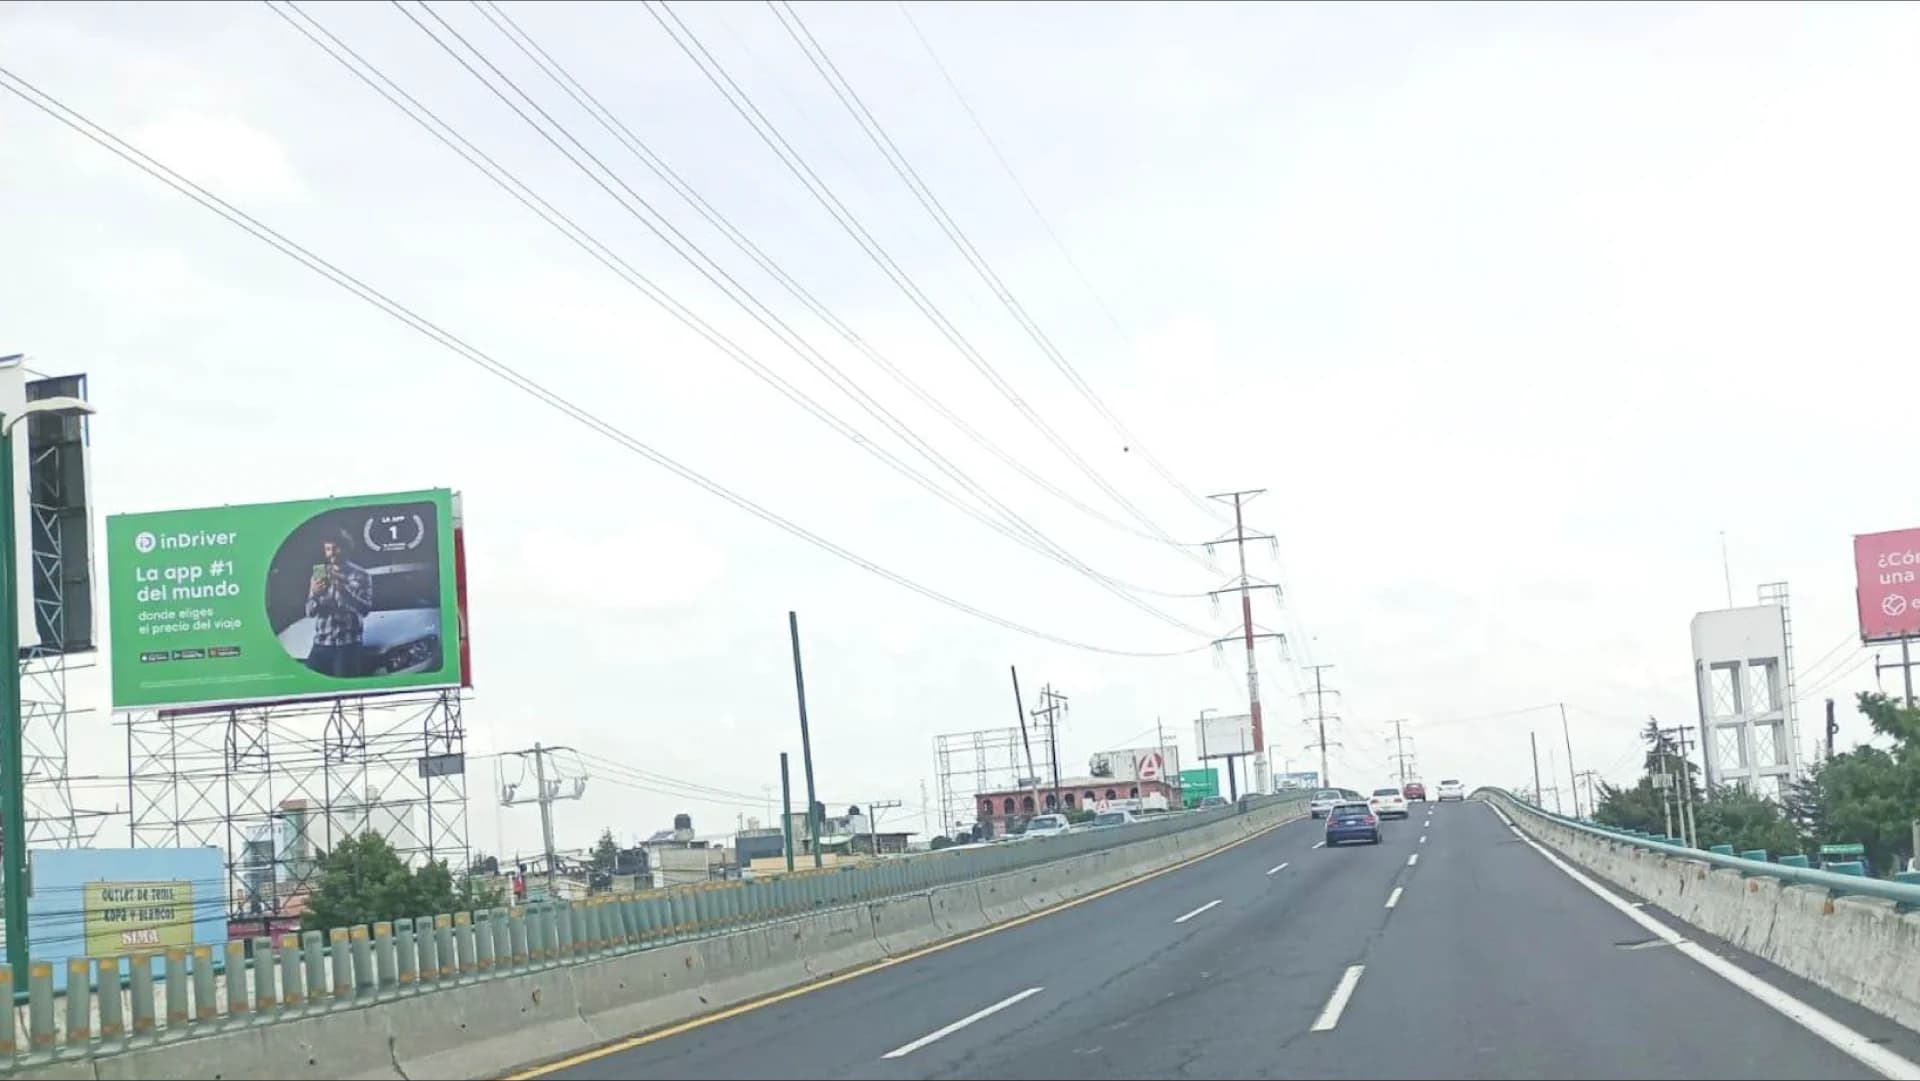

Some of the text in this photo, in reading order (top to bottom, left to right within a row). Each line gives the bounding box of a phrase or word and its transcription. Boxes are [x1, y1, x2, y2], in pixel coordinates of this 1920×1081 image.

[161, 530, 237, 549] inDriver
[389, 525, 397, 540] 1
[136, 560, 233, 584] La app #1
[1880, 570, 1914, 585] una
[137, 579, 240, 602] del mundo
[138, 608, 214, 621] donde eliges
[139, 617, 242, 635] el precio del viaje
[101, 888, 134, 901] OUTLET
[137, 887, 148, 900] DE
